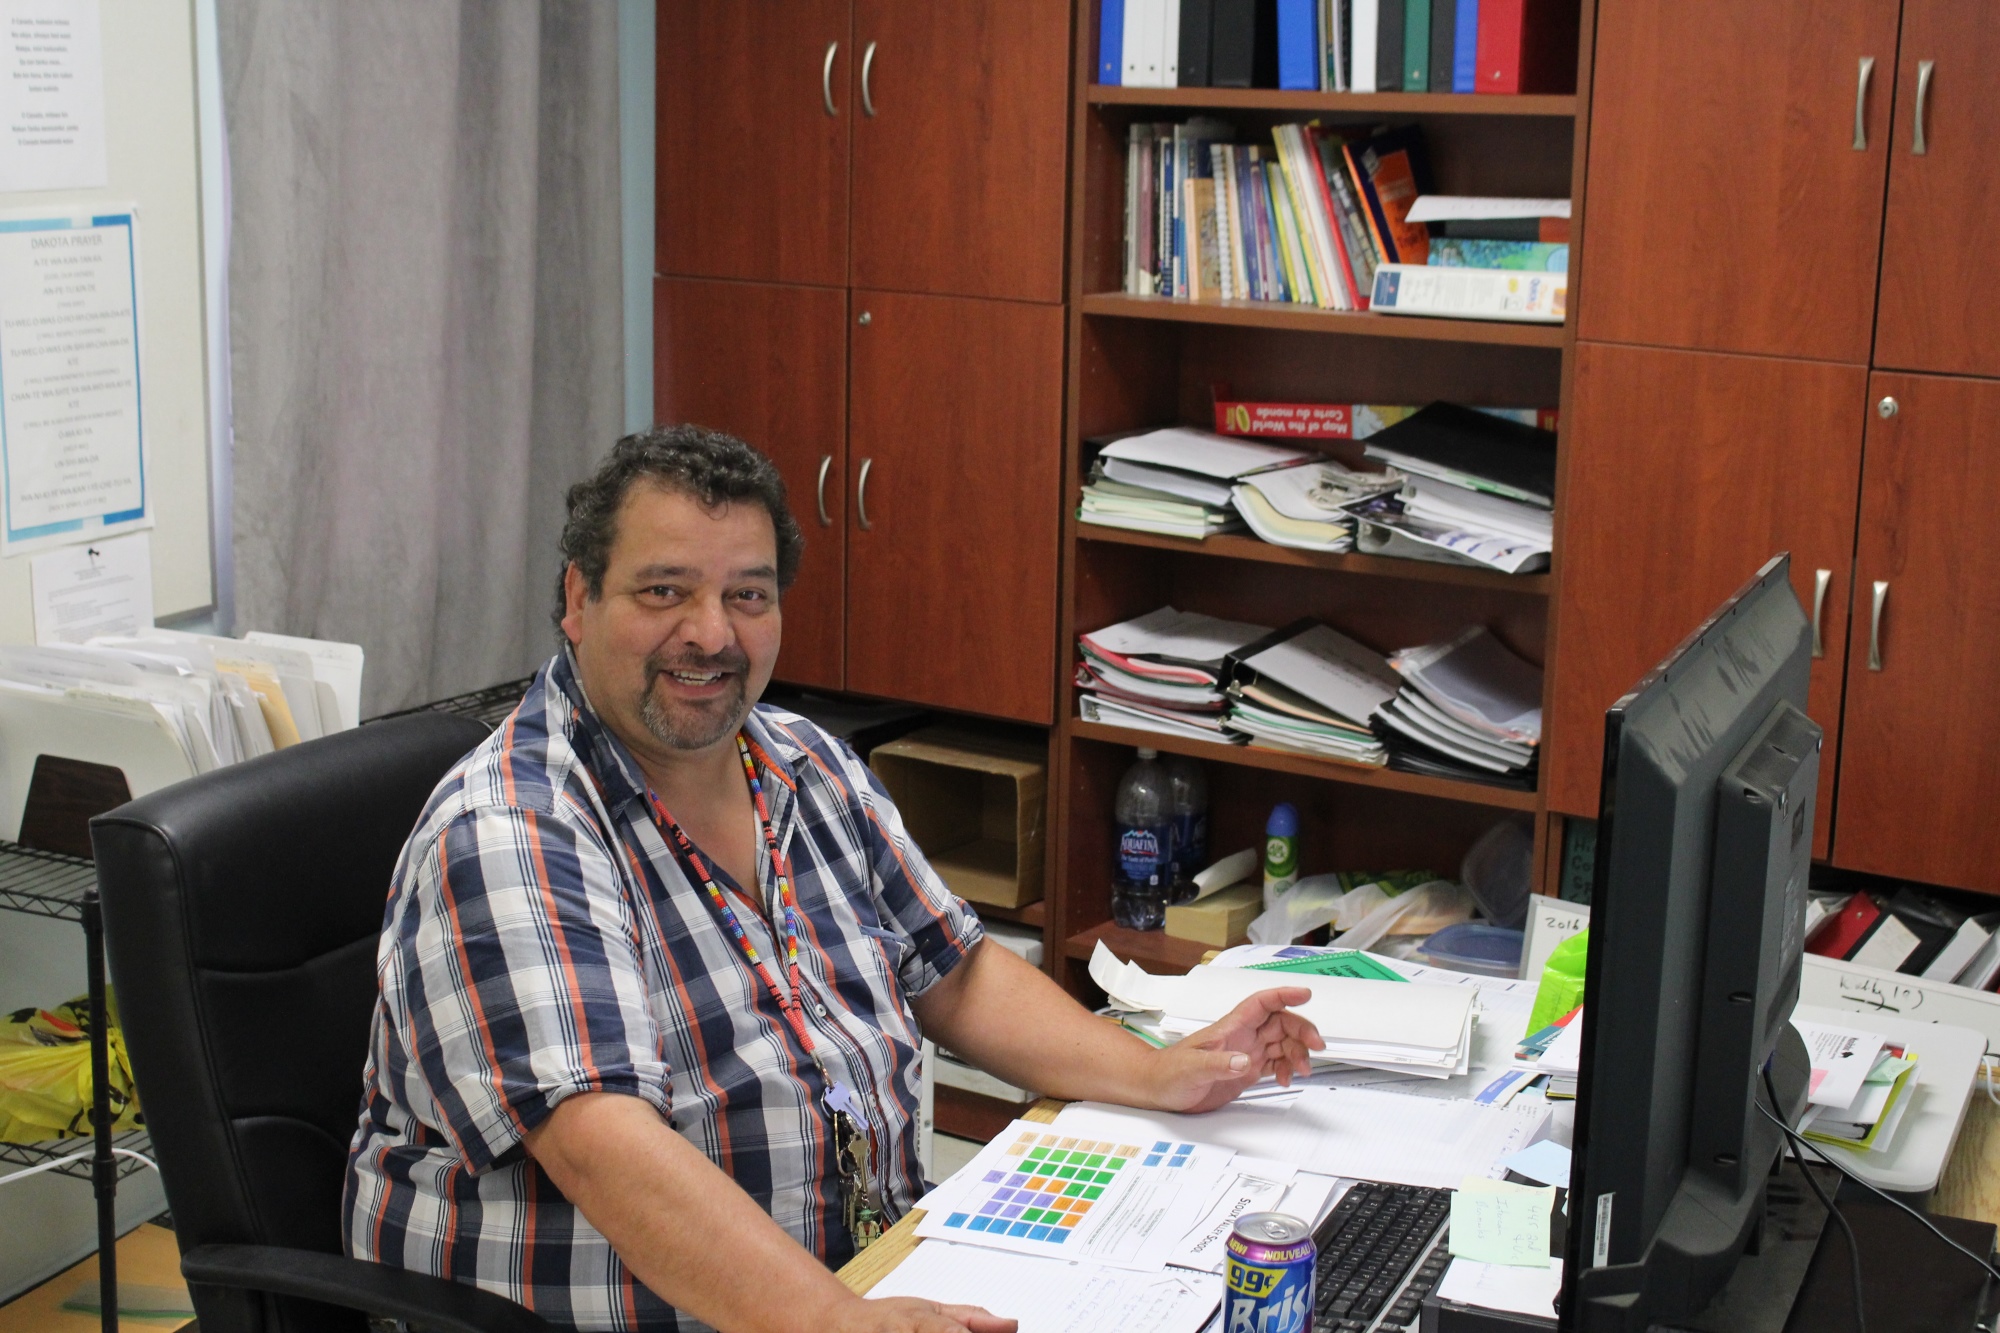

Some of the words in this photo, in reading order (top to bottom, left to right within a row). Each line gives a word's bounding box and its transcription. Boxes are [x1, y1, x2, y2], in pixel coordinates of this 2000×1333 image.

[31, 235, 69, 249] DAKOTA
[71, 234, 103, 247] PRAYER
[1256, 407, 1294, 419] monde
[1296, 408, 1311, 420] du
[1313, 409, 1344, 421] Carte
[1252, 420, 1286, 432] World
[1288, 421, 1306, 433] the
[1307, 422, 1320, 434] of
[1322, 422, 1348, 434] Map
[1545, 916, 1580, 931] 2016
[1230, 1197, 1252, 1219] SIOUX
[1190, 1234, 1218, 1253] SCHOOL
[1229, 1238, 1248, 1256] NEW!
[1263, 1243, 1310, 1261] NOUVEAU
[1230, 1264, 1275, 1293] 99¢
